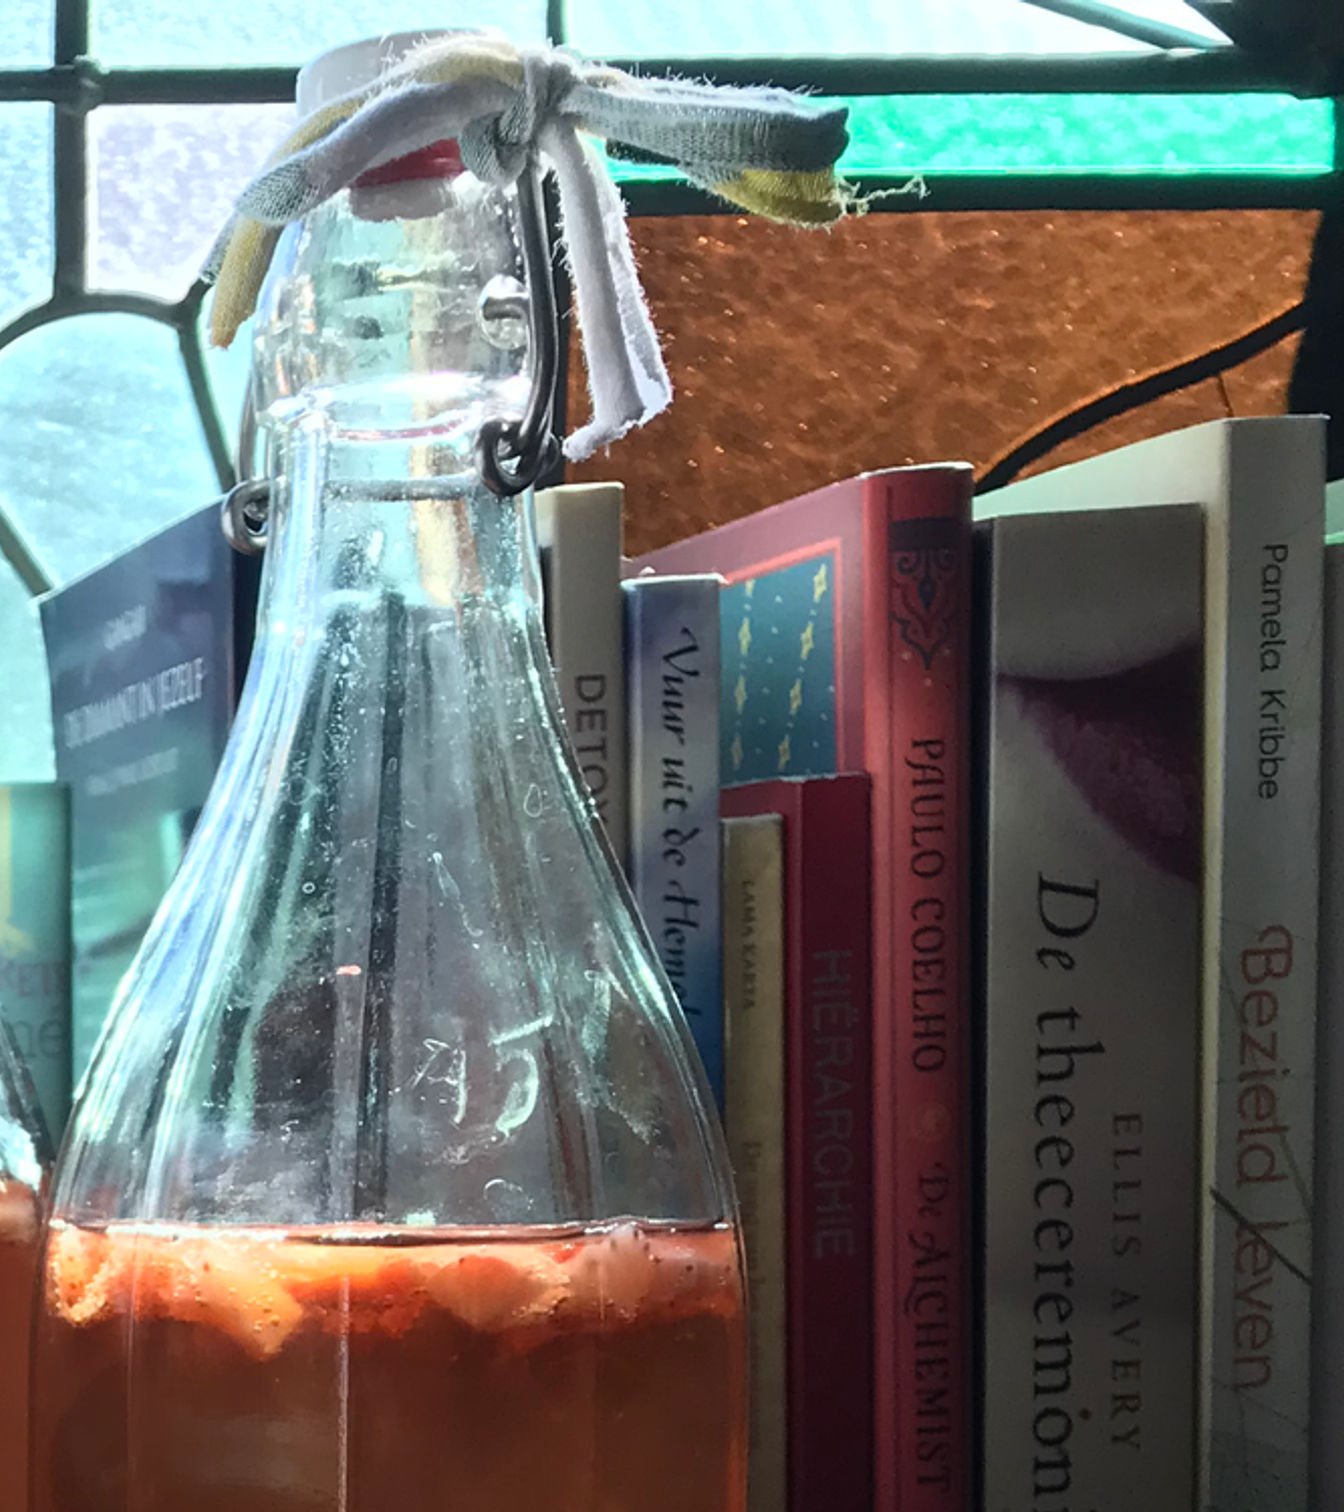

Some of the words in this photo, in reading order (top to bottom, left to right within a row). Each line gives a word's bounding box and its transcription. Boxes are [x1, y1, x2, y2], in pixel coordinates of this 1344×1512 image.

[1260, 543, 1289, 674] Pamela
[656, 625, 694, 746] Vuur
[1258, 688, 1289, 800] Kribbe
[659, 756, 692, 826] uit
[659, 830, 694, 874] de
[912, 738, 946, 882] PAULO
[911, 891, 947, 1074] COELHO
[1036, 871, 1102, 973] De
[810, 950, 854, 1261] HIËRARCHIE
[1234, 922, 1296, 1186] Bezield
[1110, 1111, 1143, 1258] ELLIS
[1108, 1288, 1143, 1452] AVERY
